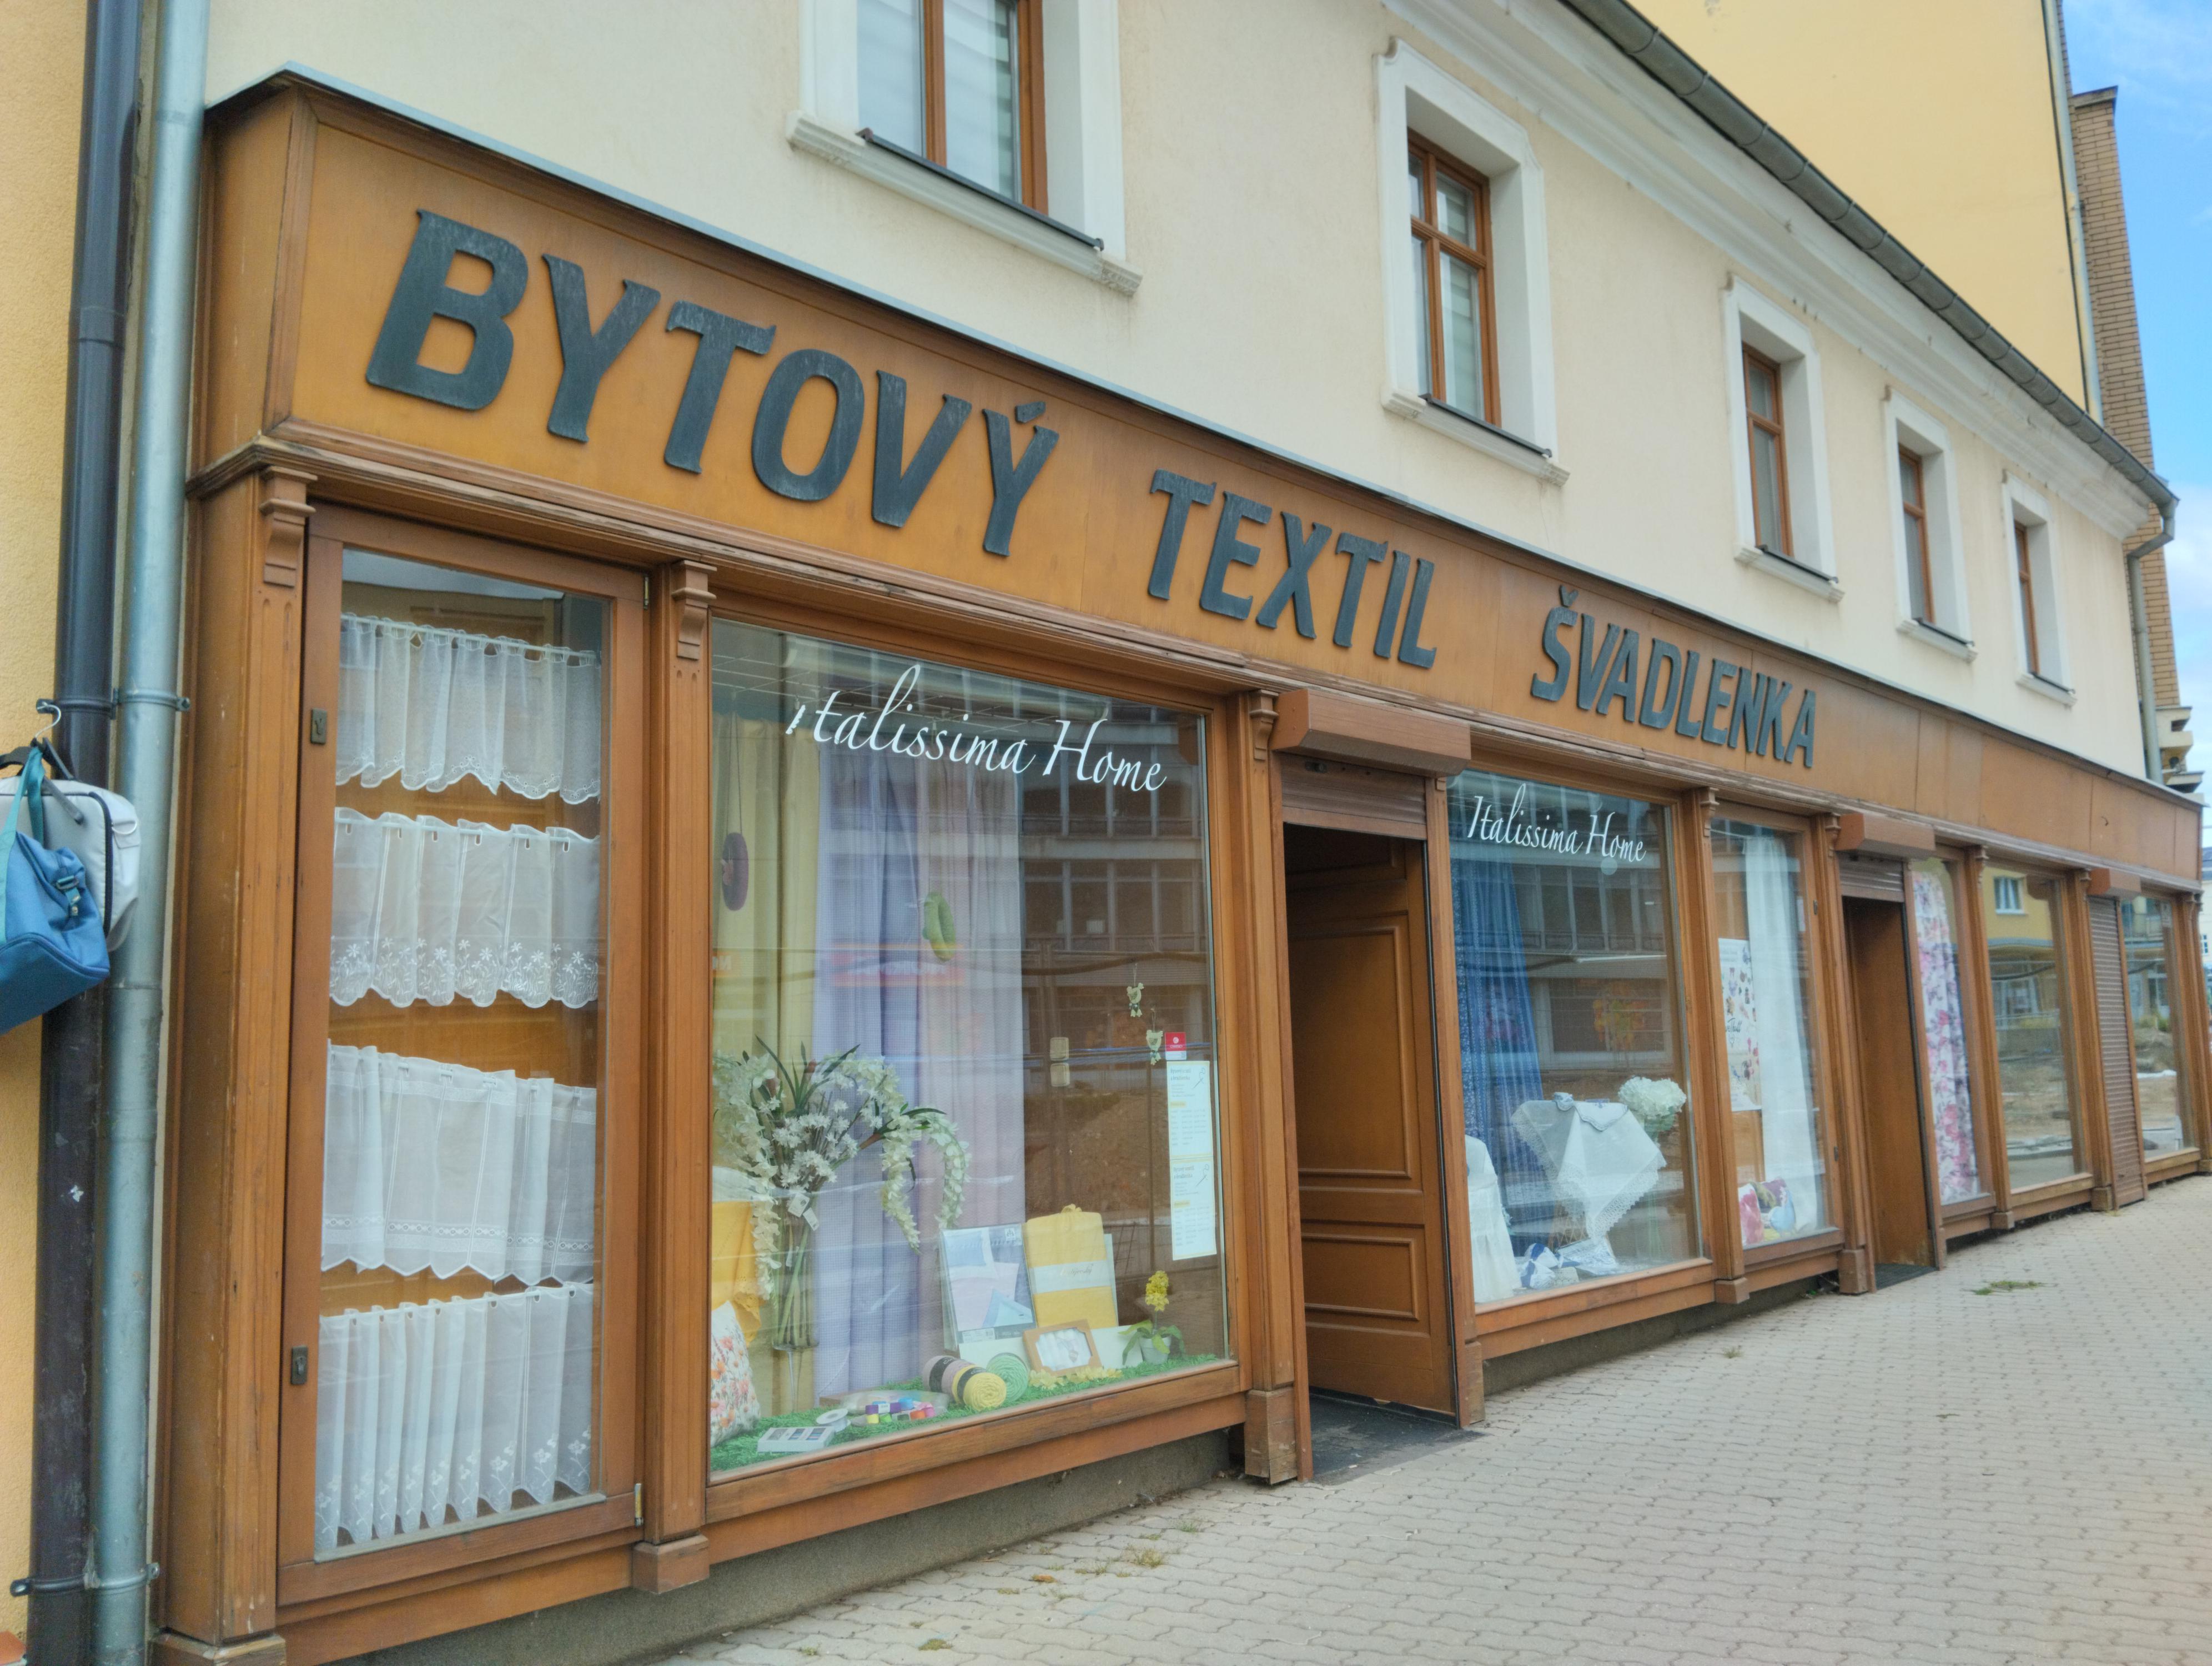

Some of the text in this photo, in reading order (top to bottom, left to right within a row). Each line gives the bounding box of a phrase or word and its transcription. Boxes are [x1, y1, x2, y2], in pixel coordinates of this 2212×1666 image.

[365, 209, 1816, 767] BYTOVÝ TEXTIL ŠVADLENKA
[1043, 719, 1167, 792] Home
[1467, 783, 1646, 862] Italissima Home
